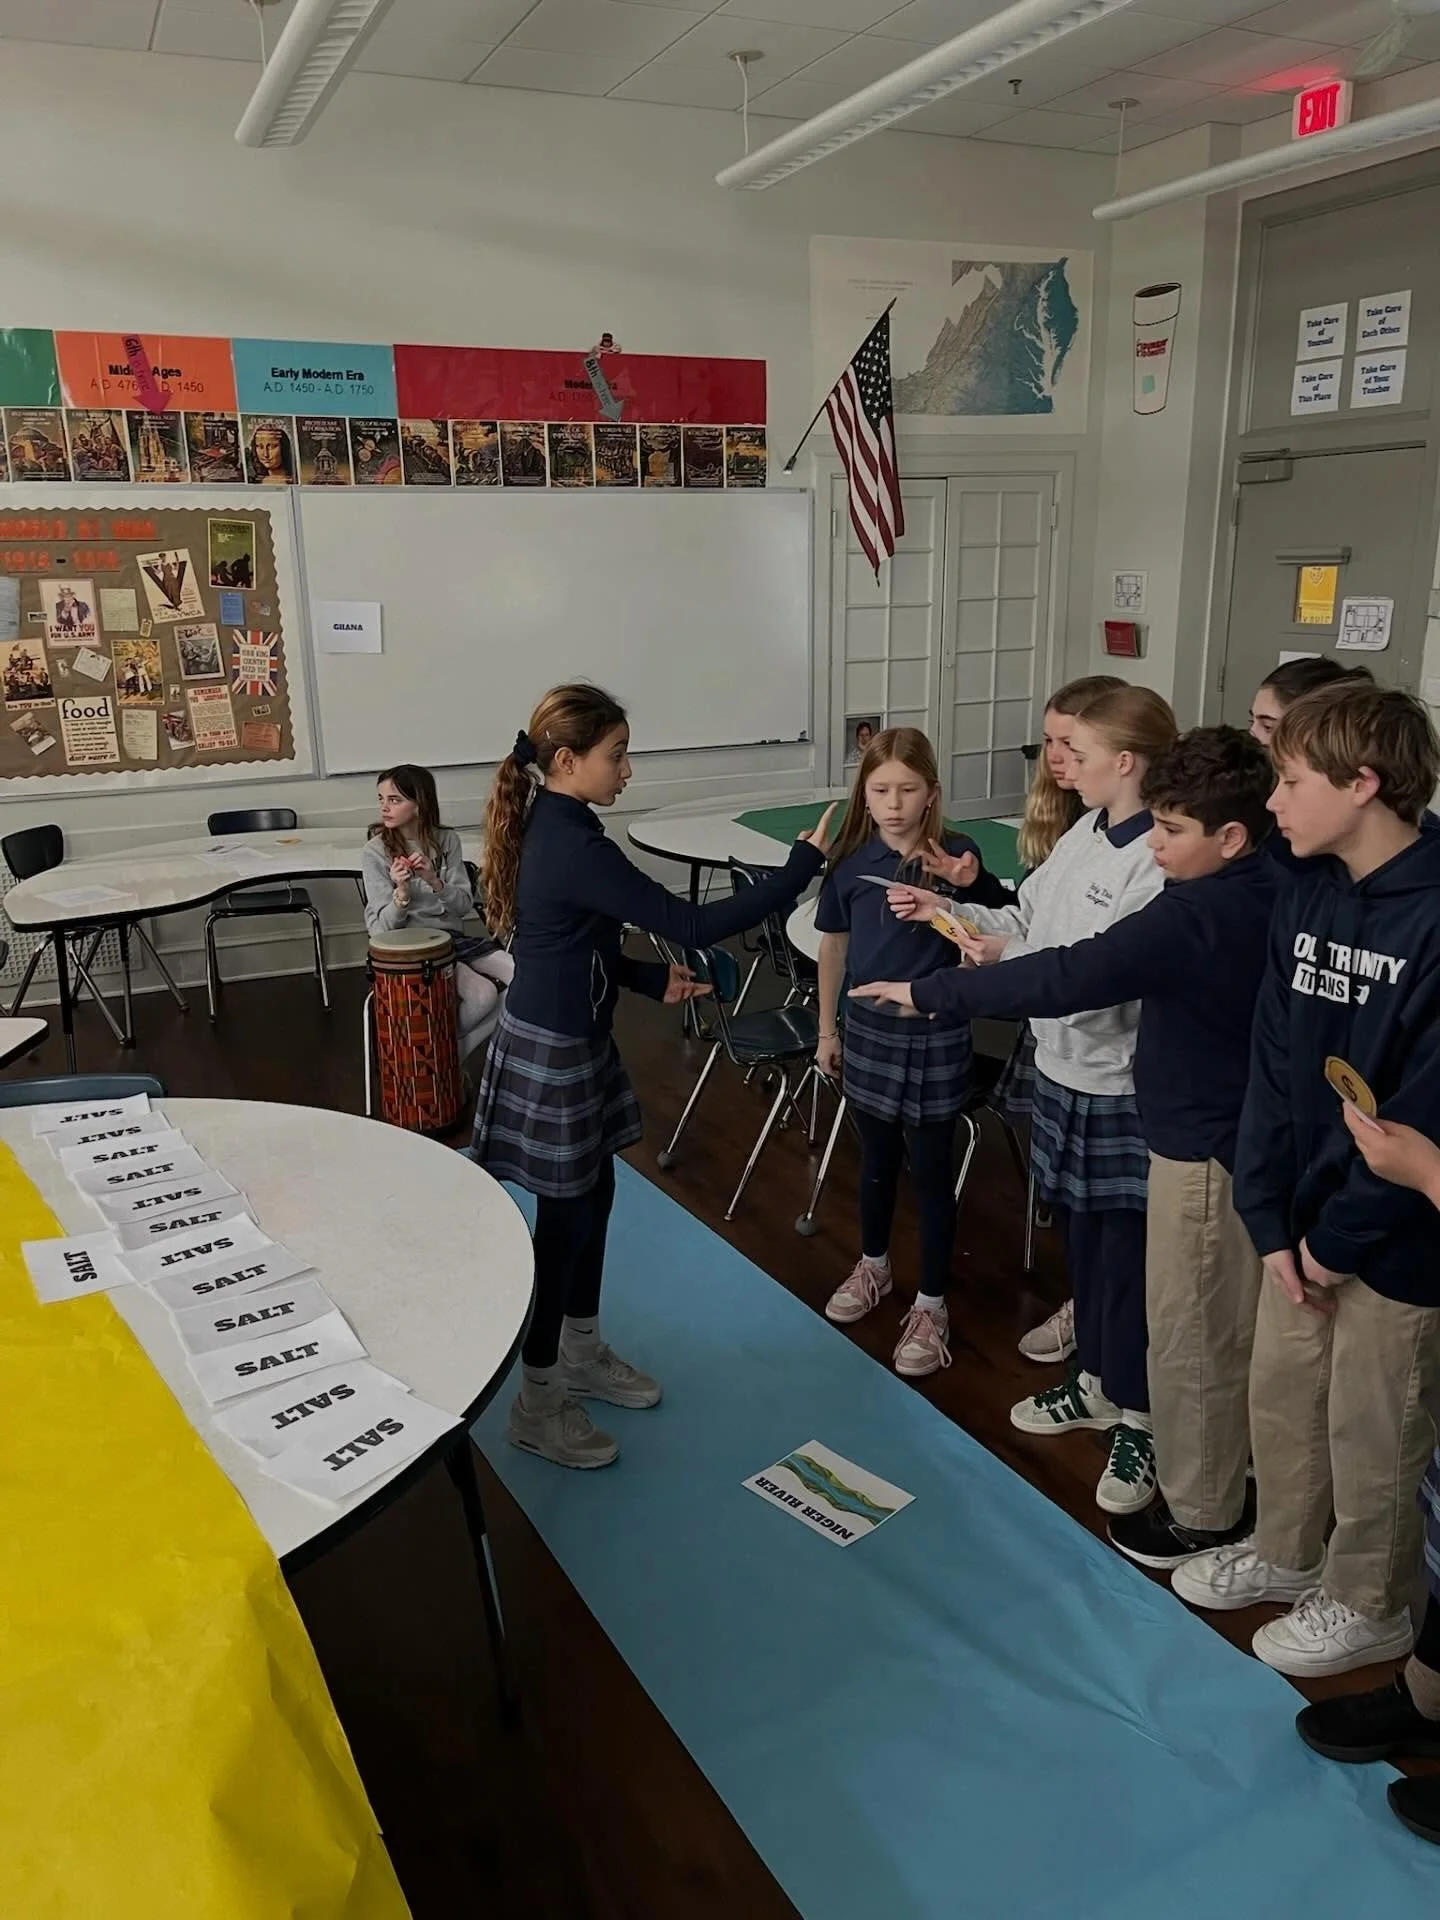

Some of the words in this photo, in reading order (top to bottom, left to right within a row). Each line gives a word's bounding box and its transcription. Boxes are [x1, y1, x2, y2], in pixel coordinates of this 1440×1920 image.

[1299, 84, 1340, 135] EXIT
[1367, 309, 1383, 317] Take
[1384, 305, 1402, 313] Care
[1378, 317, 1386, 325] of
[1306, 320, 1322, 328] Take
[1323, 317, 1340, 325] Care
[1362, 329, 1378, 338] Each
[1380, 326, 1401, 335] Other
[152, 366, 182, 379] Ages
[271, 368, 299, 381] Early
[302, 369, 344, 380] Modern
[346, 370, 364, 381] Era
[1301, 375, 1316, 383] Take
[1318, 373, 1334, 381] Care
[1361, 367, 1378, 375] Take
[1379, 364, 1396, 372] Care
[178, 382, 204, 393] 1450
[263, 382, 285, 393] A.D.
[290, 383, 315, 393] 1450
[324, 384, 345, 395] A.D.
[350, 384, 375, 395] 1750
[55, 624, 77, 632] WANT
[79, 623, 95, 632] YOU
[332, 623, 364, 631] GHANA
[62, 697, 110, 719] food
[1293, 932, 1318, 963] OL
[1327, 941, 1408, 985] TRINTY
[1297, 967, 1347, 1000] TIANS
[60, 1108, 124, 1123] SALT
[78, 1127, 142, 1144] SALT
[93, 1145, 158, 1163] SALT
[107, 1163, 174, 1184] SALT
[133, 1188, 202, 1210] SALT
[150, 1211, 222, 1233] SALT
[161, 1238, 234, 1266] SALT
[64, 1251, 97, 1282] SALT
[192, 1264, 267, 1295] SALT
[214, 1302, 295, 1331] SALT
[235, 1342, 319, 1376] SALT
[272, 1384, 355, 1429] SALT
[323, 1418, 404, 1471] SALT
[755, 1477, 804, 1509] RIVER
[802, 1507, 855, 1540] NIGER
